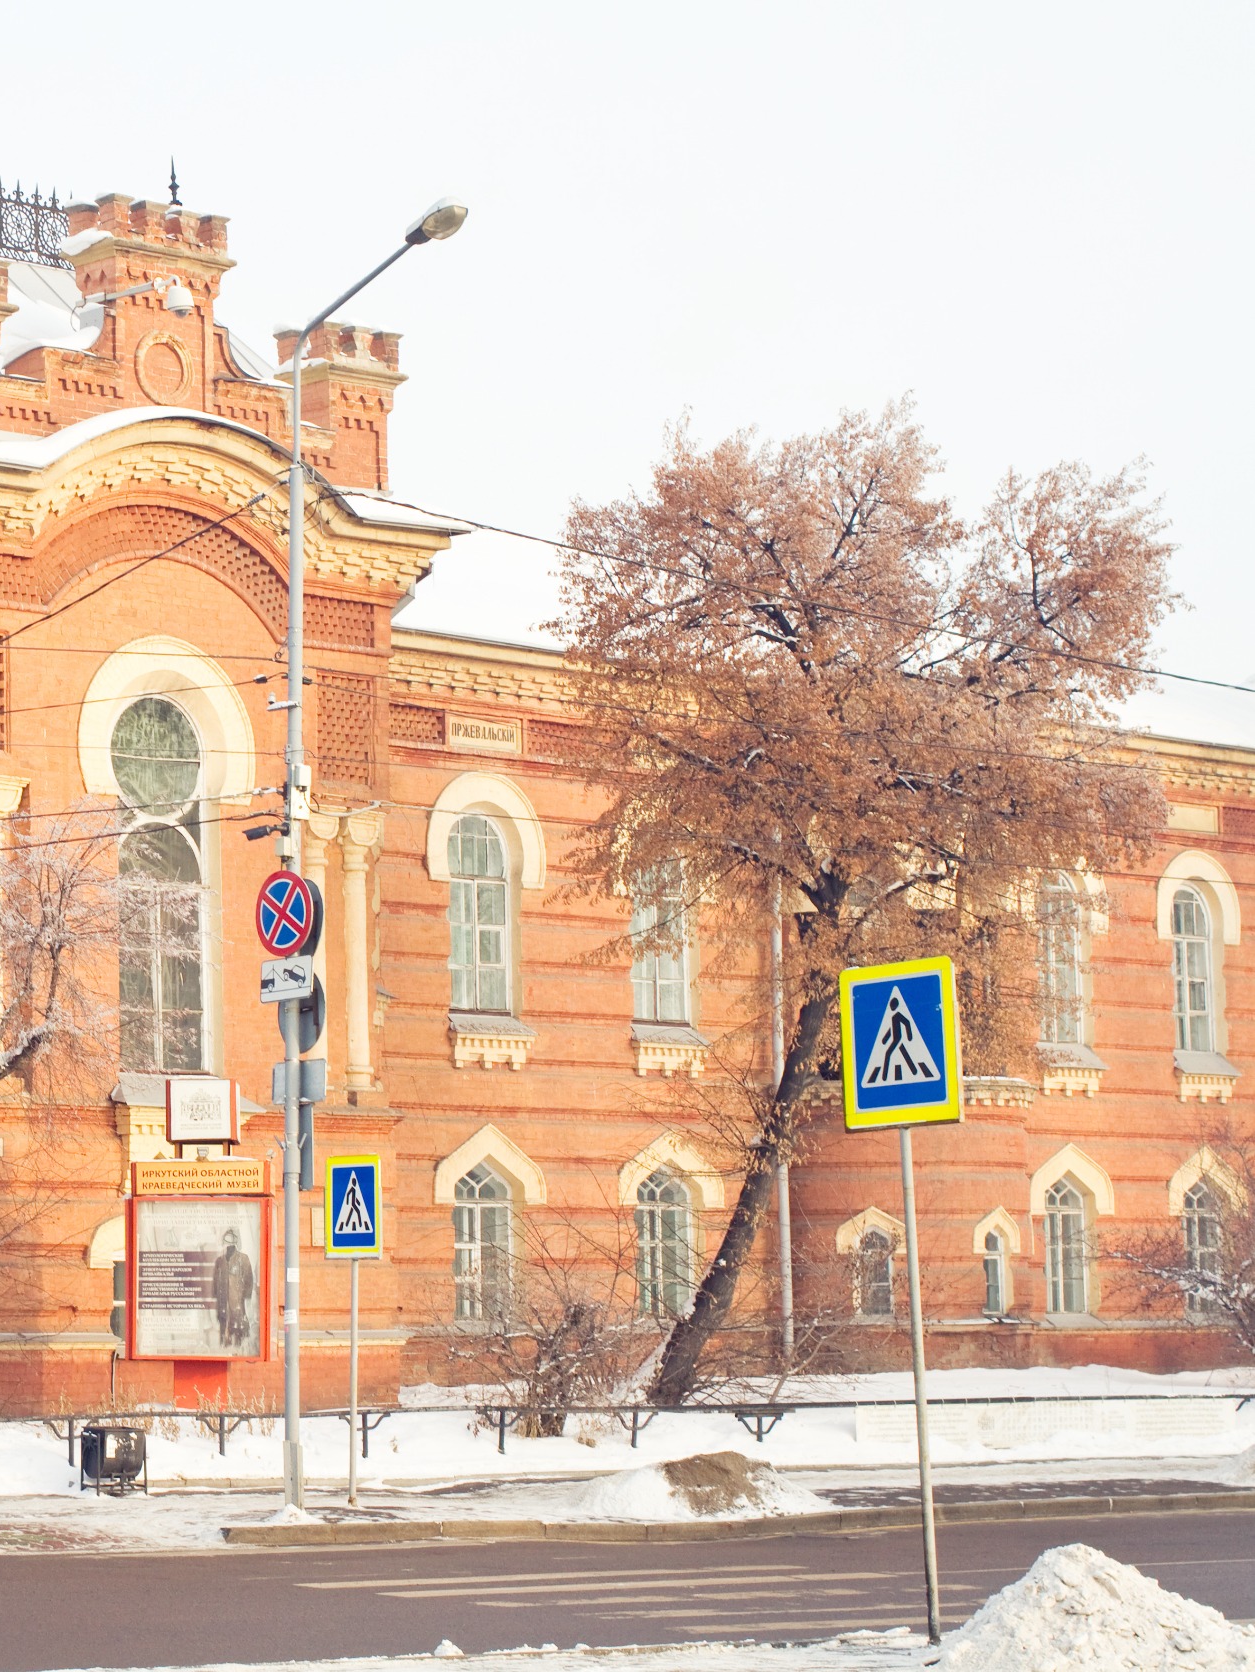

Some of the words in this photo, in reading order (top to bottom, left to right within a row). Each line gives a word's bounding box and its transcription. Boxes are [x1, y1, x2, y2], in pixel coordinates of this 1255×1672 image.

[142, 1167, 198, 1178] ИРКУТСКИЙ
[200, 1166, 259, 1177] ОБЛАСТНОЙ
[142, 1180, 222, 1190] КРАЕВЕДЧЕСКИЙ
[226, 1179, 259, 1189] МУЗЕЙ
